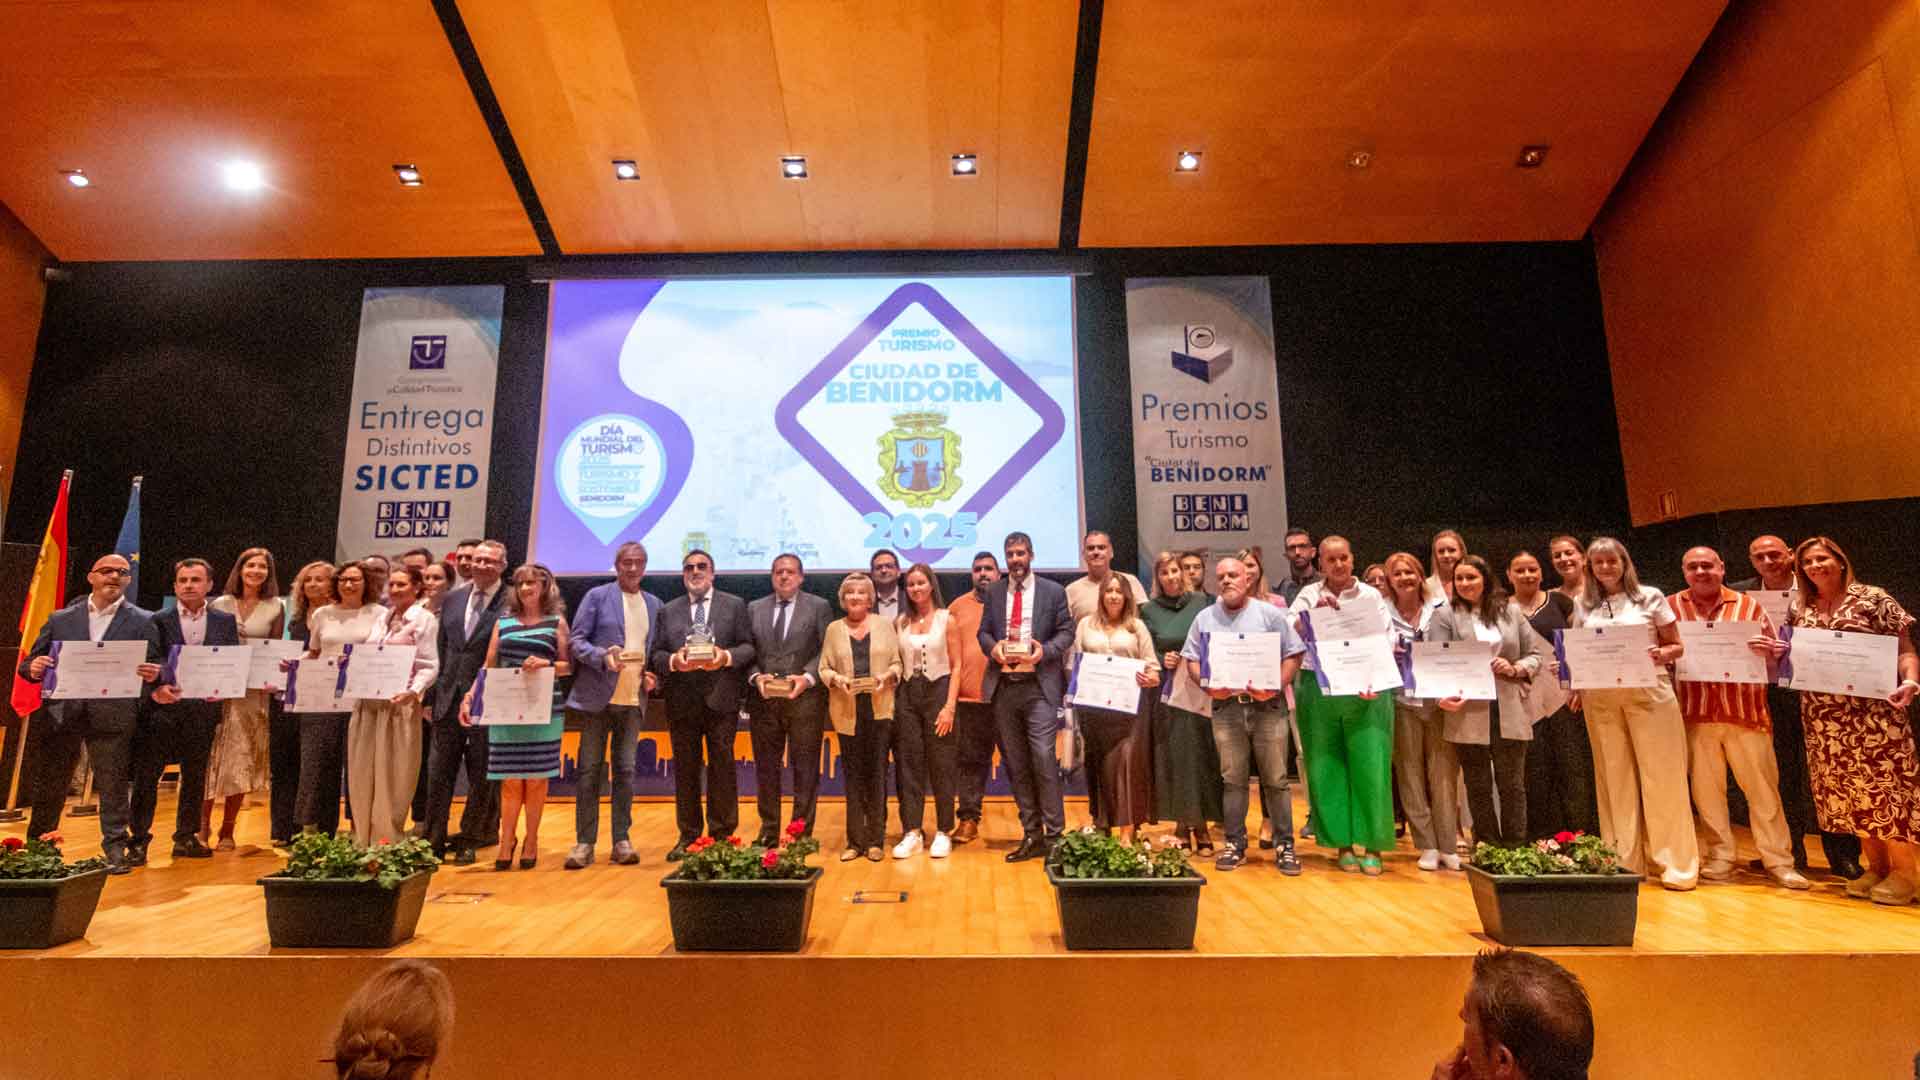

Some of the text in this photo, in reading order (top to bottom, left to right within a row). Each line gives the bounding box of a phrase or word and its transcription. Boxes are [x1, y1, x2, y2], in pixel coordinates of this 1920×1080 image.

[892, 328, 940, 337] PREMIO
[878, 340, 955, 351] TURISMO
[850, 364, 979, 379] CIUDAD DE
[827, 381, 1002, 403] BENIDORM
[1141, 393, 1268, 422] Premios
[360, 402, 484, 436] Entrega
[600, 424, 624, 435] DÍA
[367, 438, 472, 457] Distintivos
[1166, 430, 1249, 449] Turismo
[354, 464, 479, 491] SICTED
[377, 502, 451, 519] BENI
[1174, 495, 1248, 512] BENI
[376, 520, 449, 538] DORM
[864, 512, 977, 549] 2025
[1174, 514, 1249, 531] DORM
